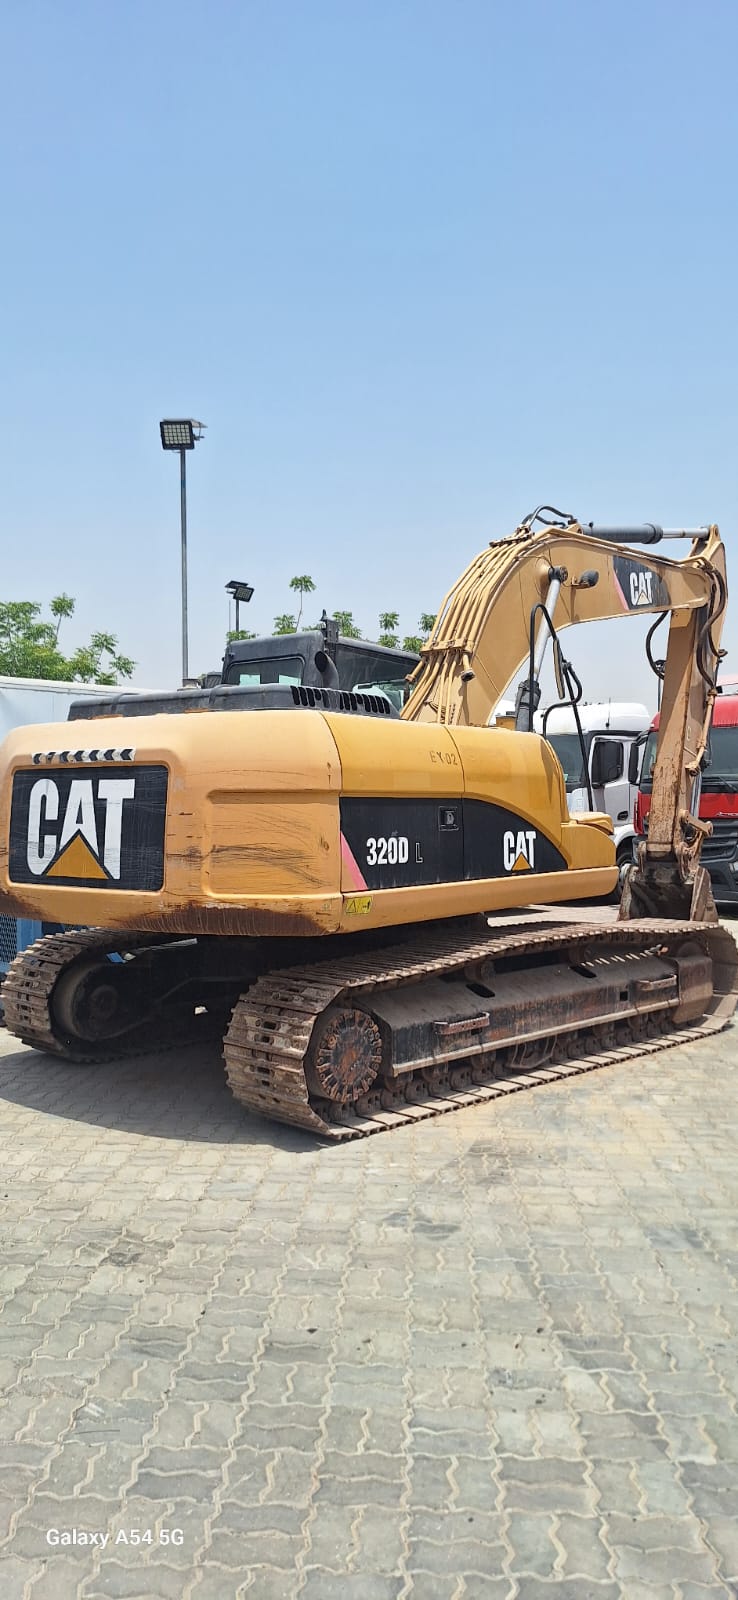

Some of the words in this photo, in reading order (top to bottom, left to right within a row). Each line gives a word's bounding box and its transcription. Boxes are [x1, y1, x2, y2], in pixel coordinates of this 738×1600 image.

[630, 572, 652, 605] CAT
[27, 779, 135, 880] CAT
[366, 836, 409, 866] 320D
[415, 842, 423, 863] L
[503, 830, 536, 871] CAT
